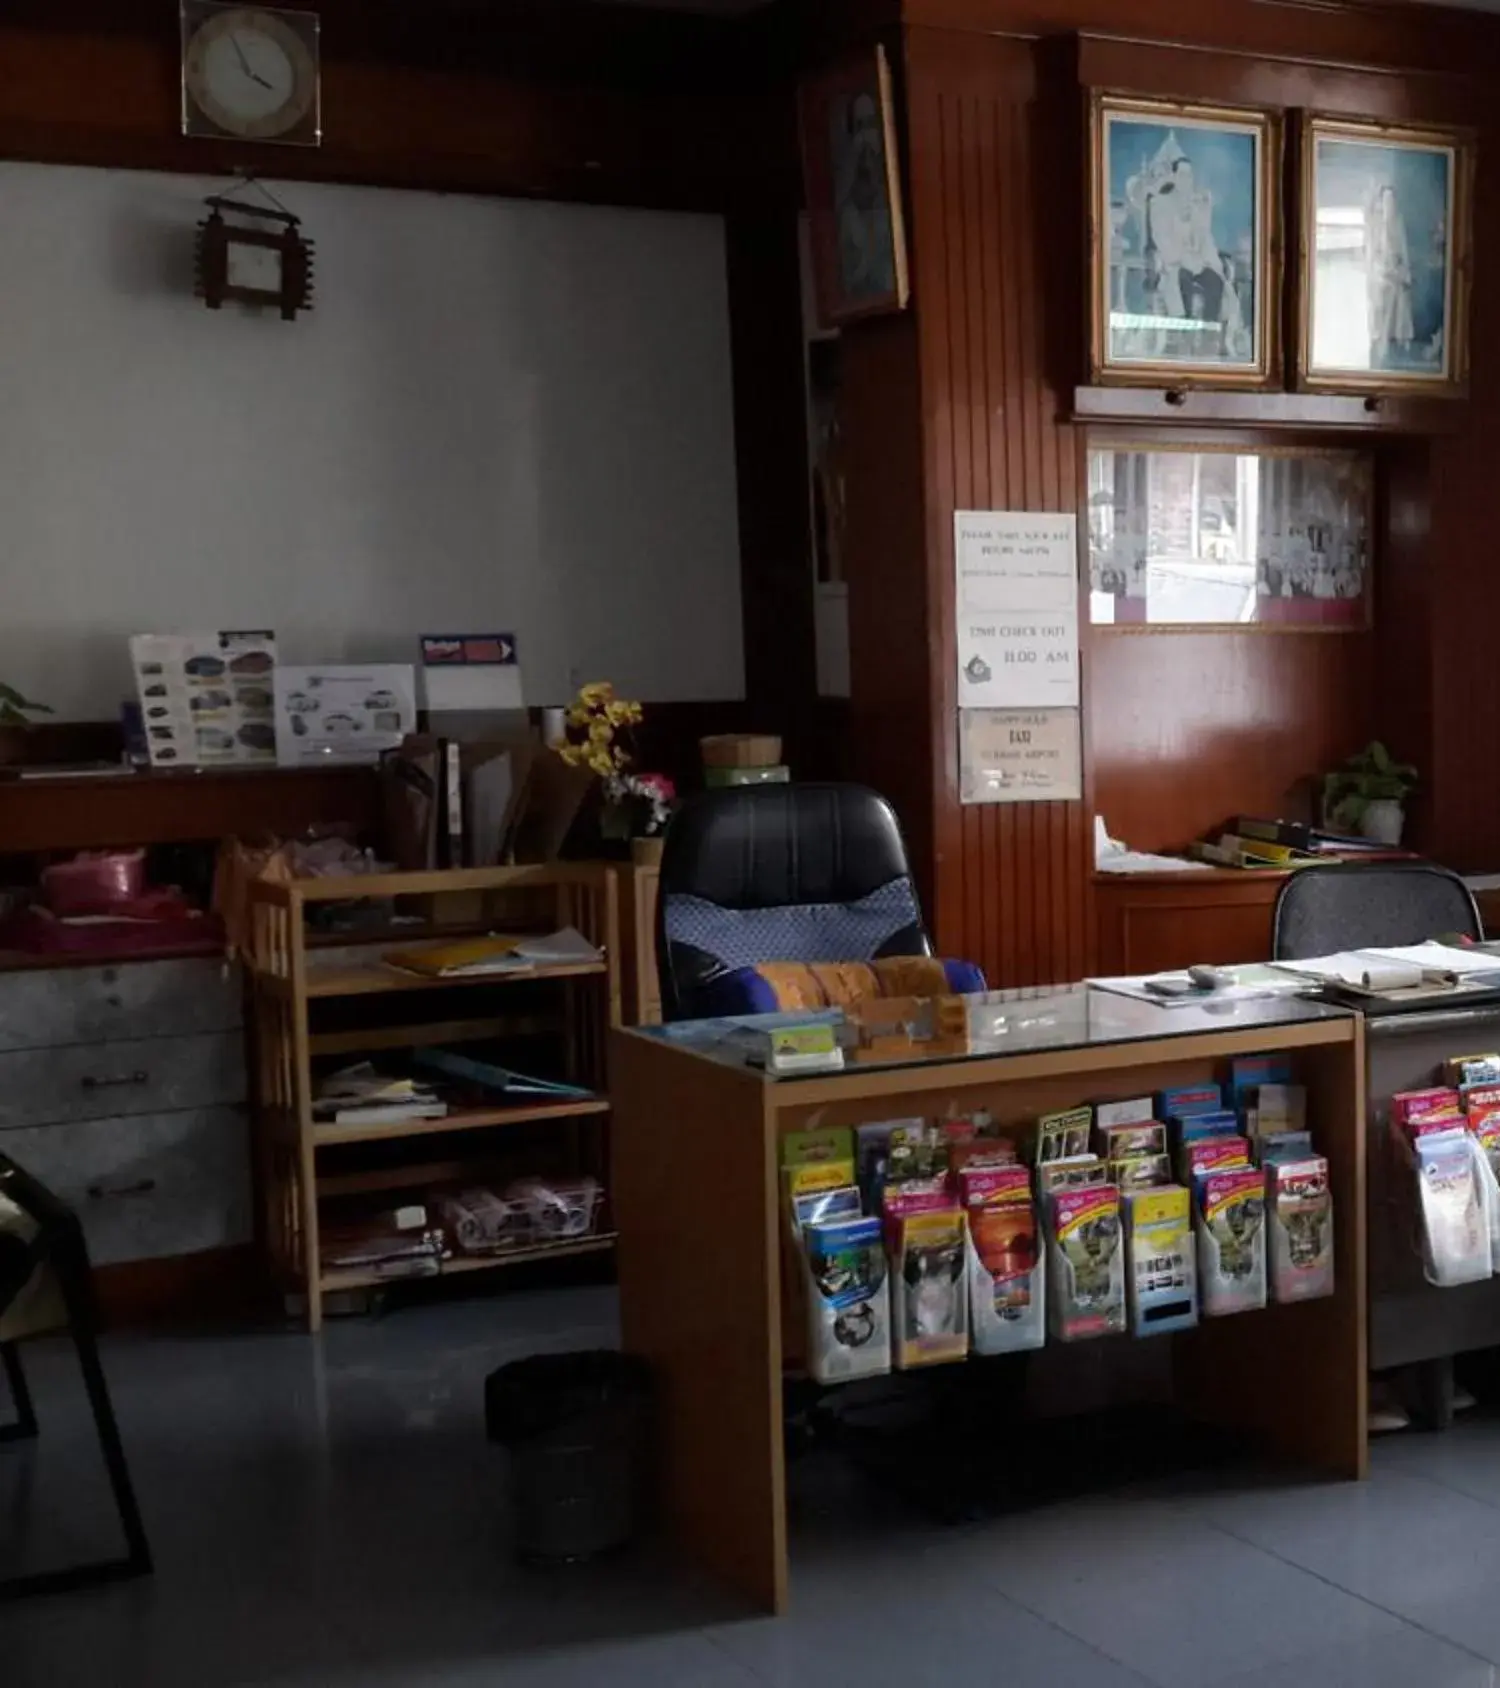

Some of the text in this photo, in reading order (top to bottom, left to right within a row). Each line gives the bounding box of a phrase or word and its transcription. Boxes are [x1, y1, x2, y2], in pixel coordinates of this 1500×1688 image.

[1000, 625, 1037, 638] CHECK
[1041, 624, 1066, 638] OUT
[1044, 650, 1071, 664] AM
